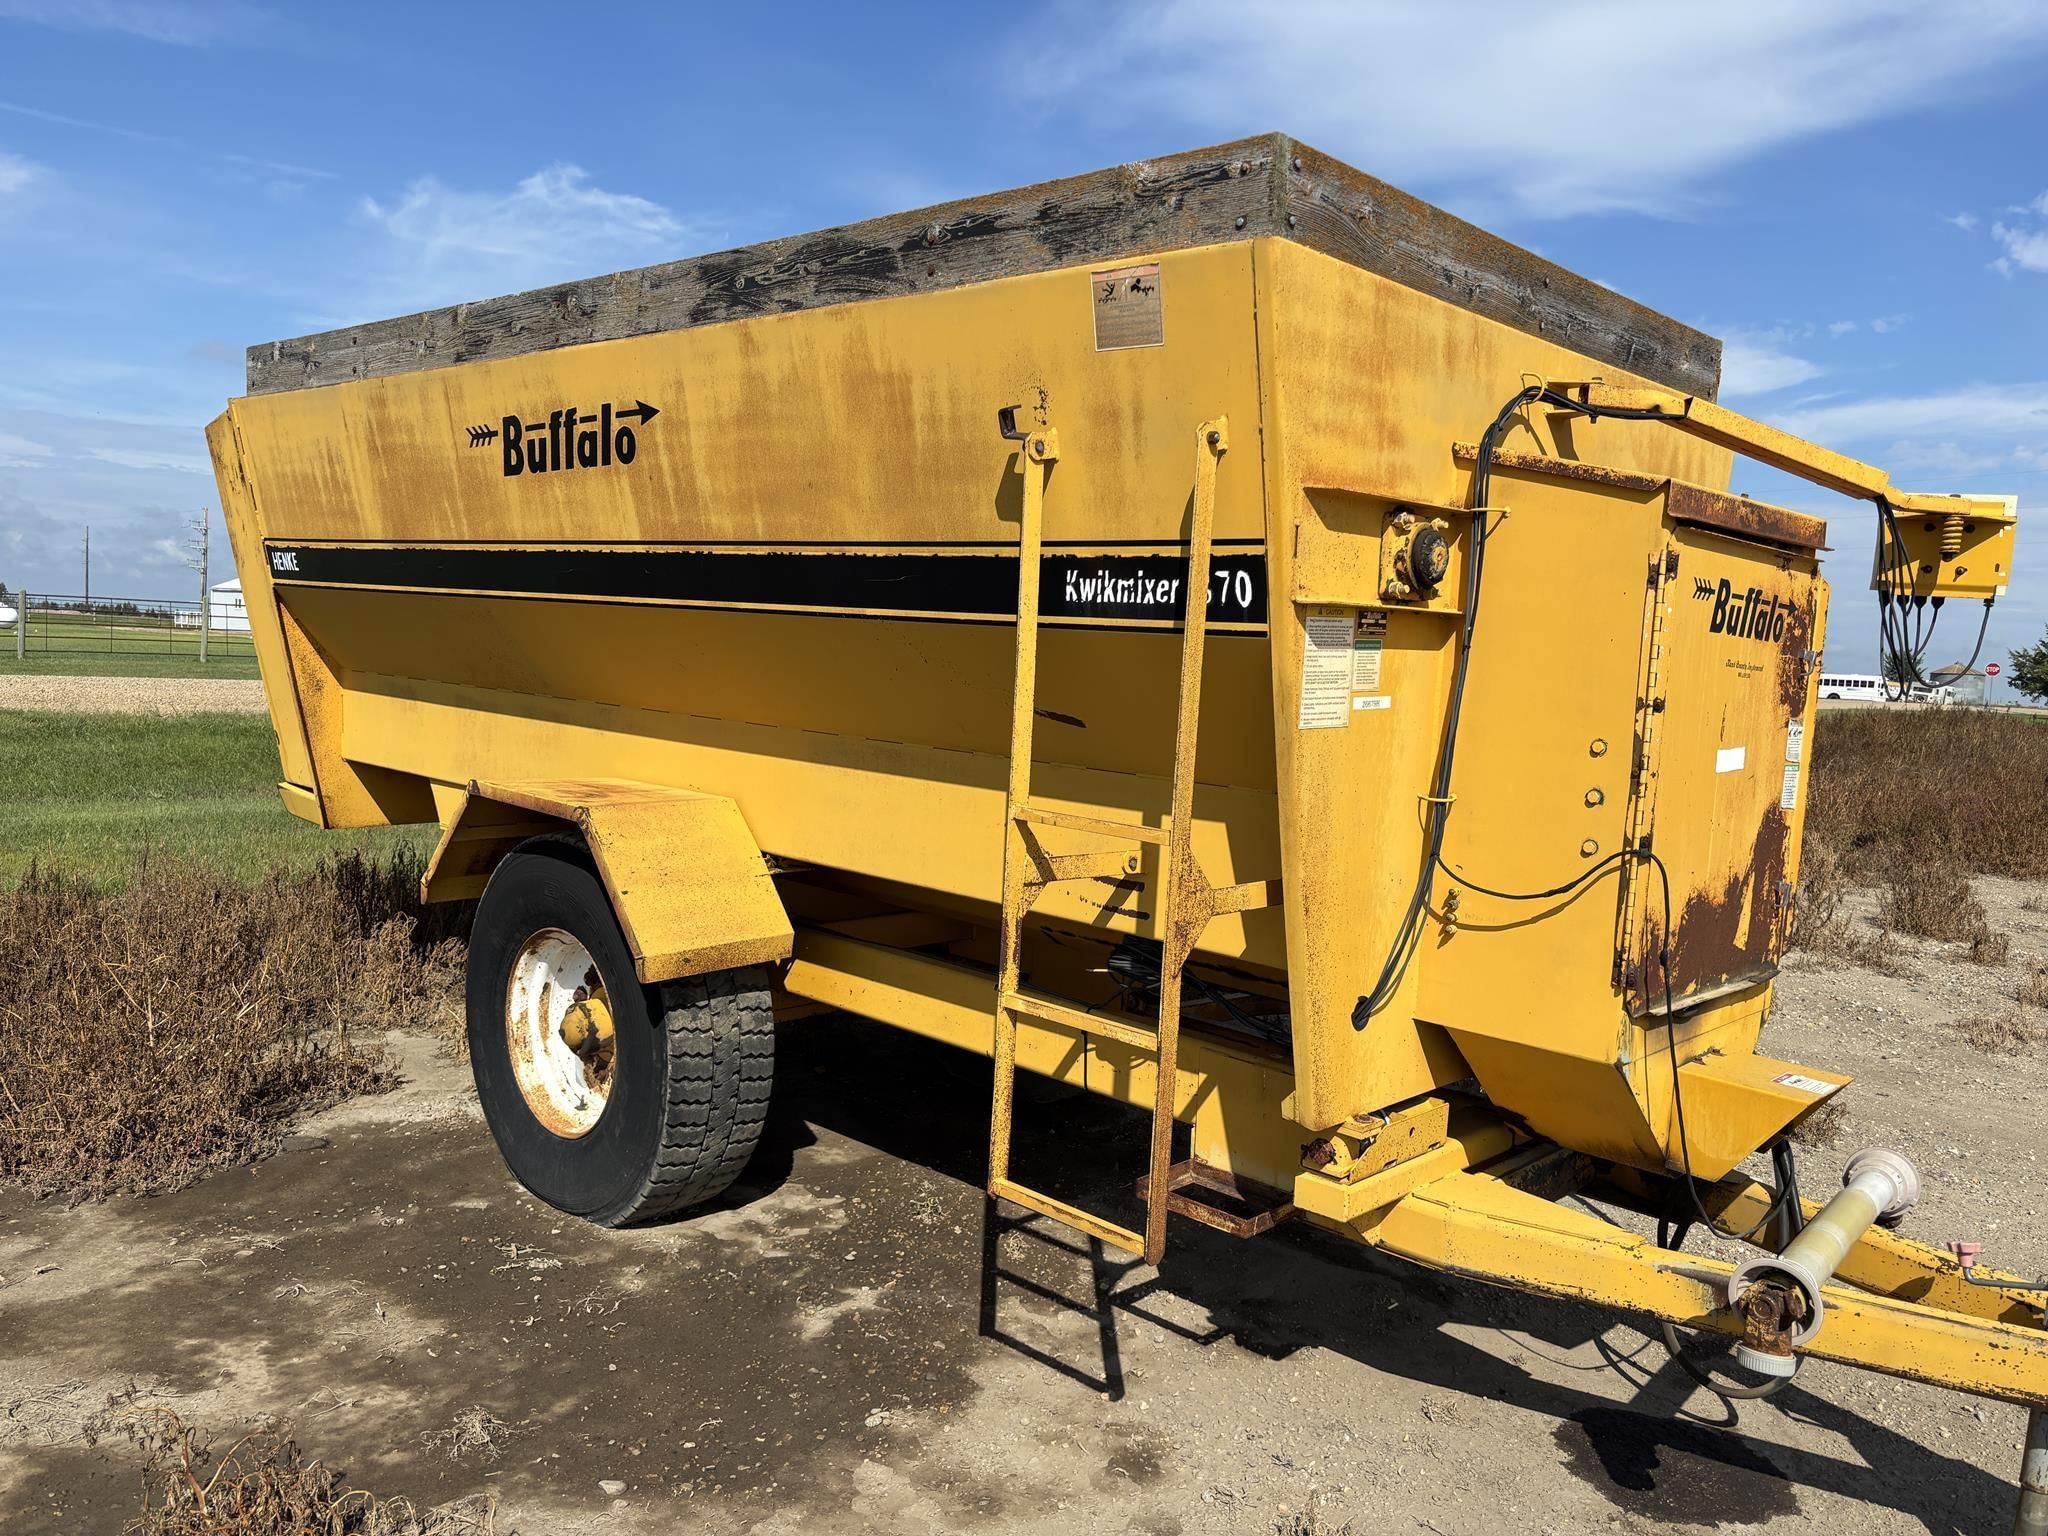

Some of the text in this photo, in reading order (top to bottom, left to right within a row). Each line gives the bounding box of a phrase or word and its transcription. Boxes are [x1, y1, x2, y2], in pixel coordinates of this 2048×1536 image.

[502, 402, 636, 477] Buffalo
[272, 552, 300, 571] HENKE
[1065, 569, 1253, 608] Kwikmixer 70
[1325, 608, 1345, 616] CAUTION
[1709, 578, 1785, 643] Buffalo
